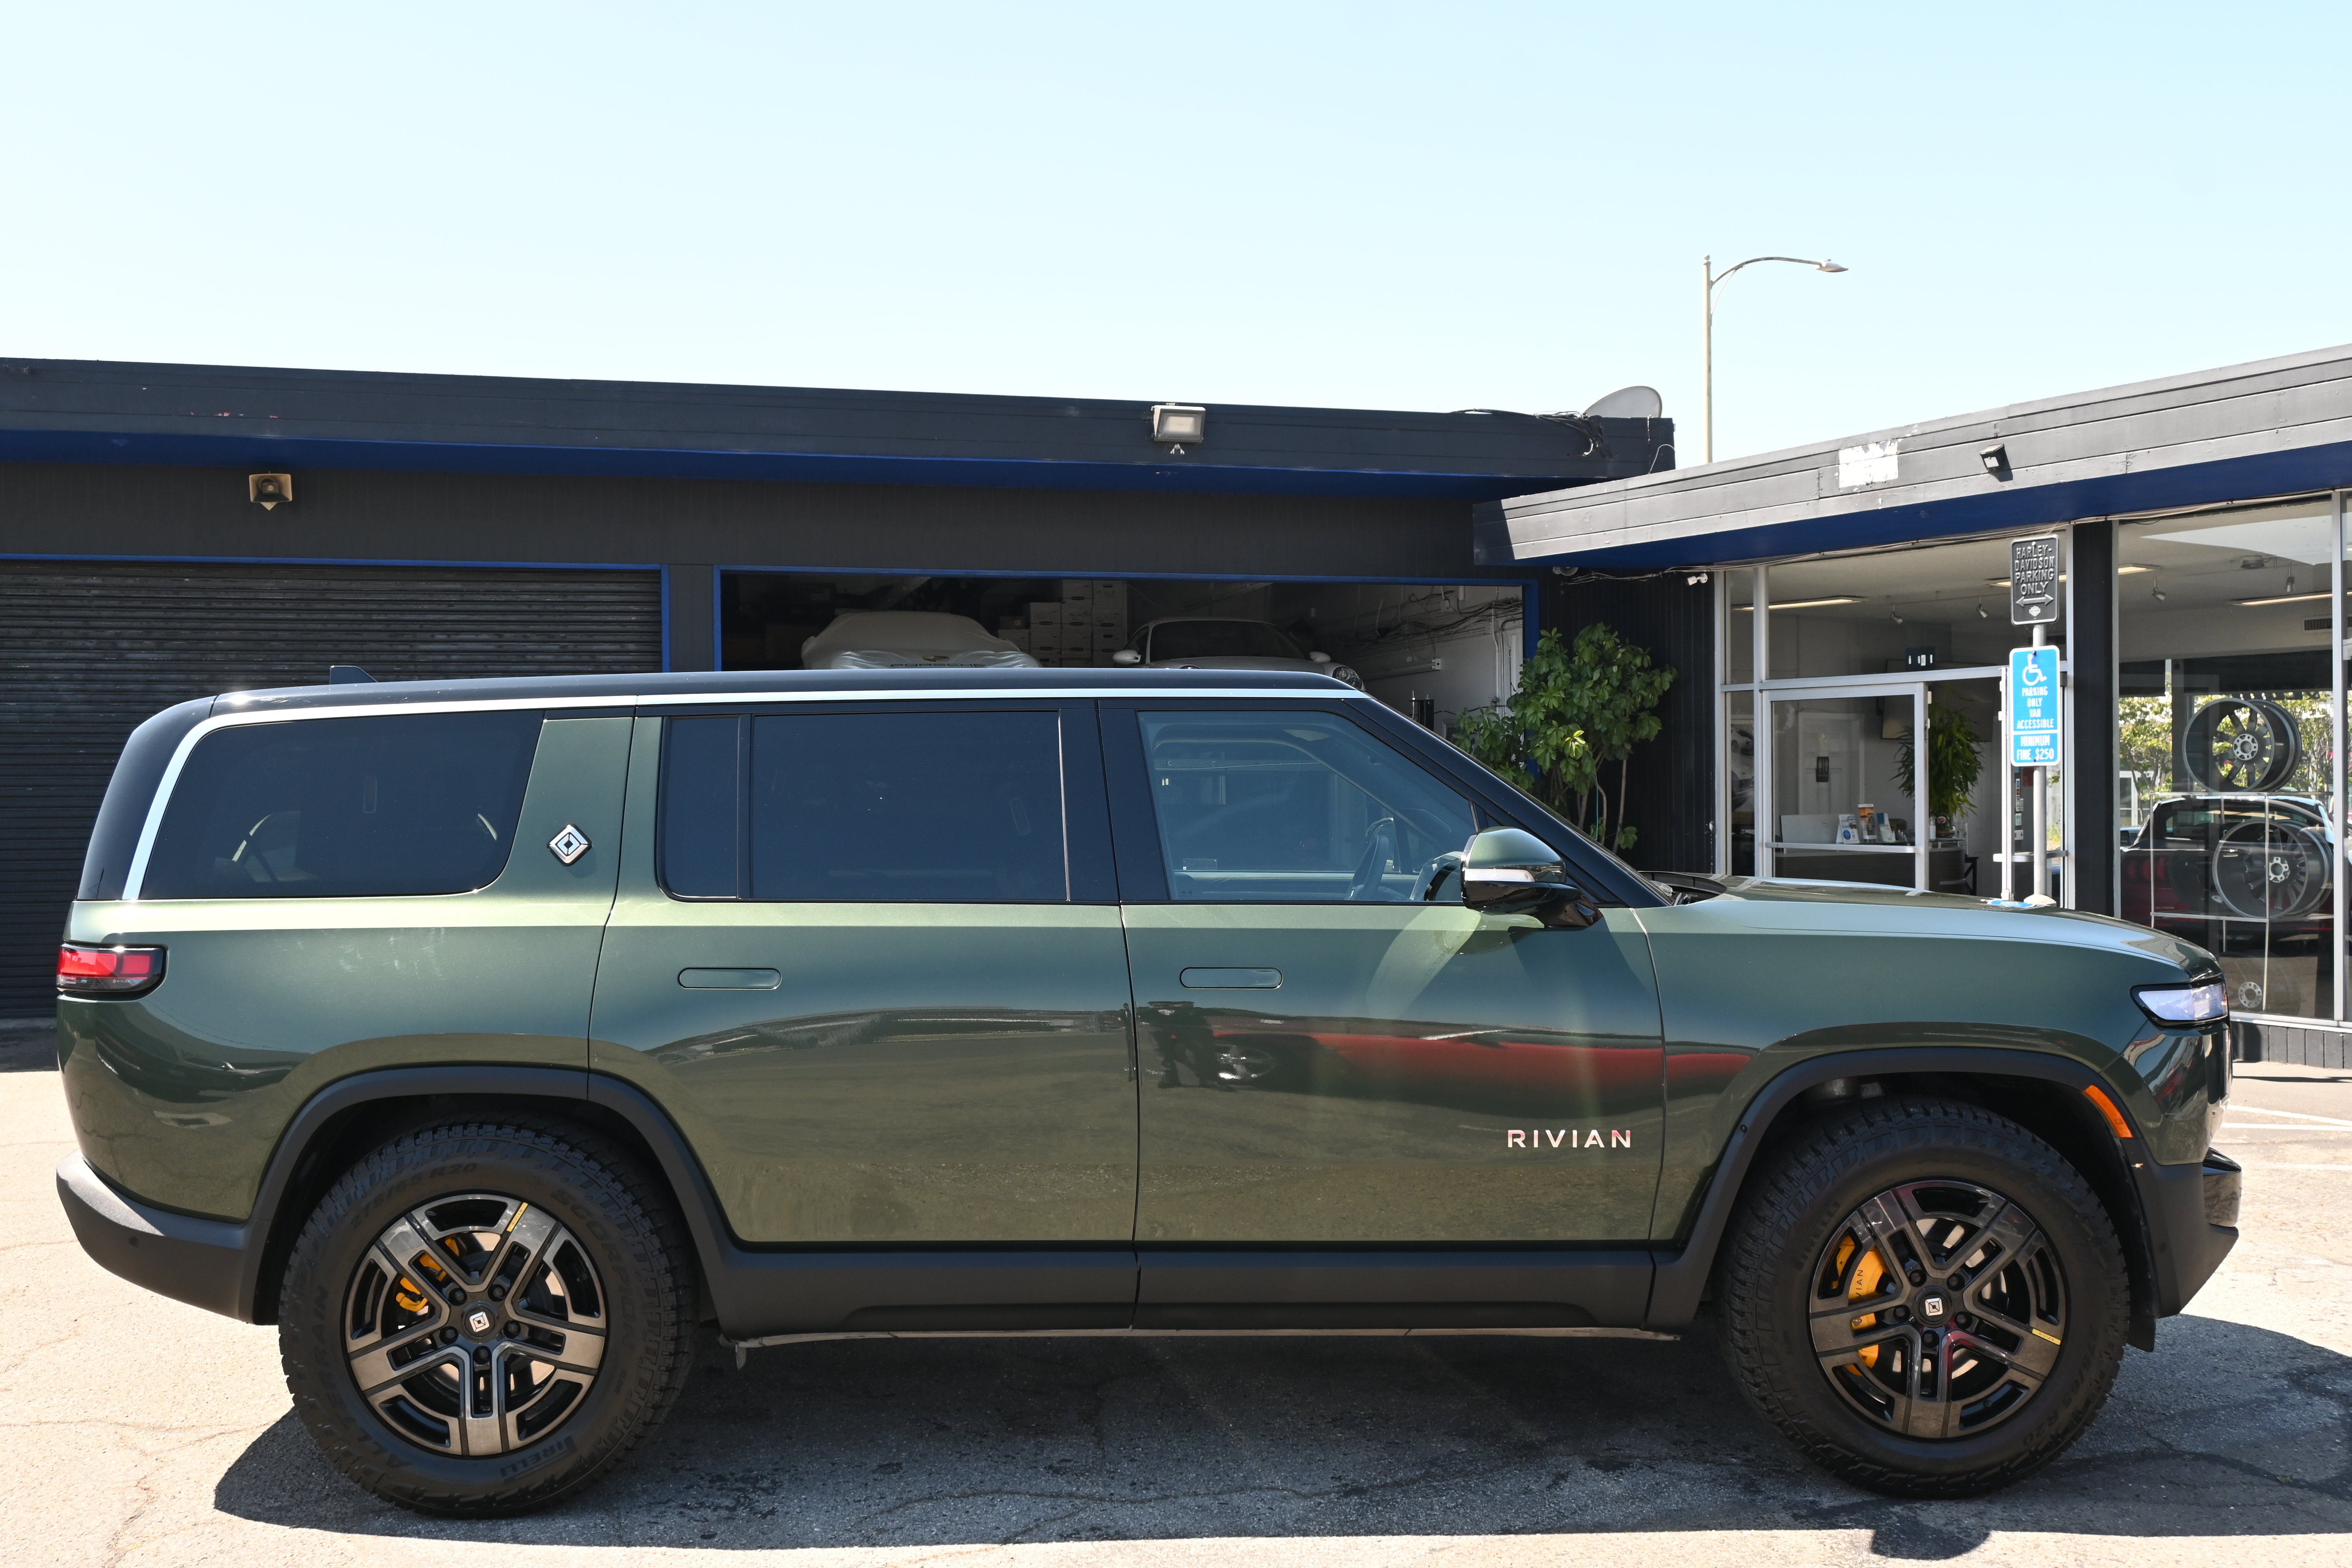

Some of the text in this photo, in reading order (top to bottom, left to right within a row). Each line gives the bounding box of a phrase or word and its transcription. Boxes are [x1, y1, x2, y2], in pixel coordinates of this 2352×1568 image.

[2017, 544, 2052, 560] HARLEY-
[2014, 556, 2055, 572] DAVIDSON
[2015, 568, 2054, 584] PARKING
[2020, 581, 2049, 596] ONLY
[2022, 686, 2048, 697] PARKING
[2027, 697, 2043, 708] ONLY
[2029, 708, 2042, 718] VAN
[2017, 718, 2054, 730] ACCESSIBLE
[2020, 735, 2050, 747] MINIMUM
[2017, 747, 2054, 761] FINE $250
[1507, 1129, 1631, 1148] RIVIAN
[350, 1162, 479, 1231] 275/65 R20
[1790, 1200, 1841, 1271] PIRELLI
[550, 1189, 637, 1351] SCORPION
[2039, 1332, 2054, 1341] RIVIAN
[2023, 1409, 2060, 1446] R20
[500, 1435, 577, 1481] PIRELLI
